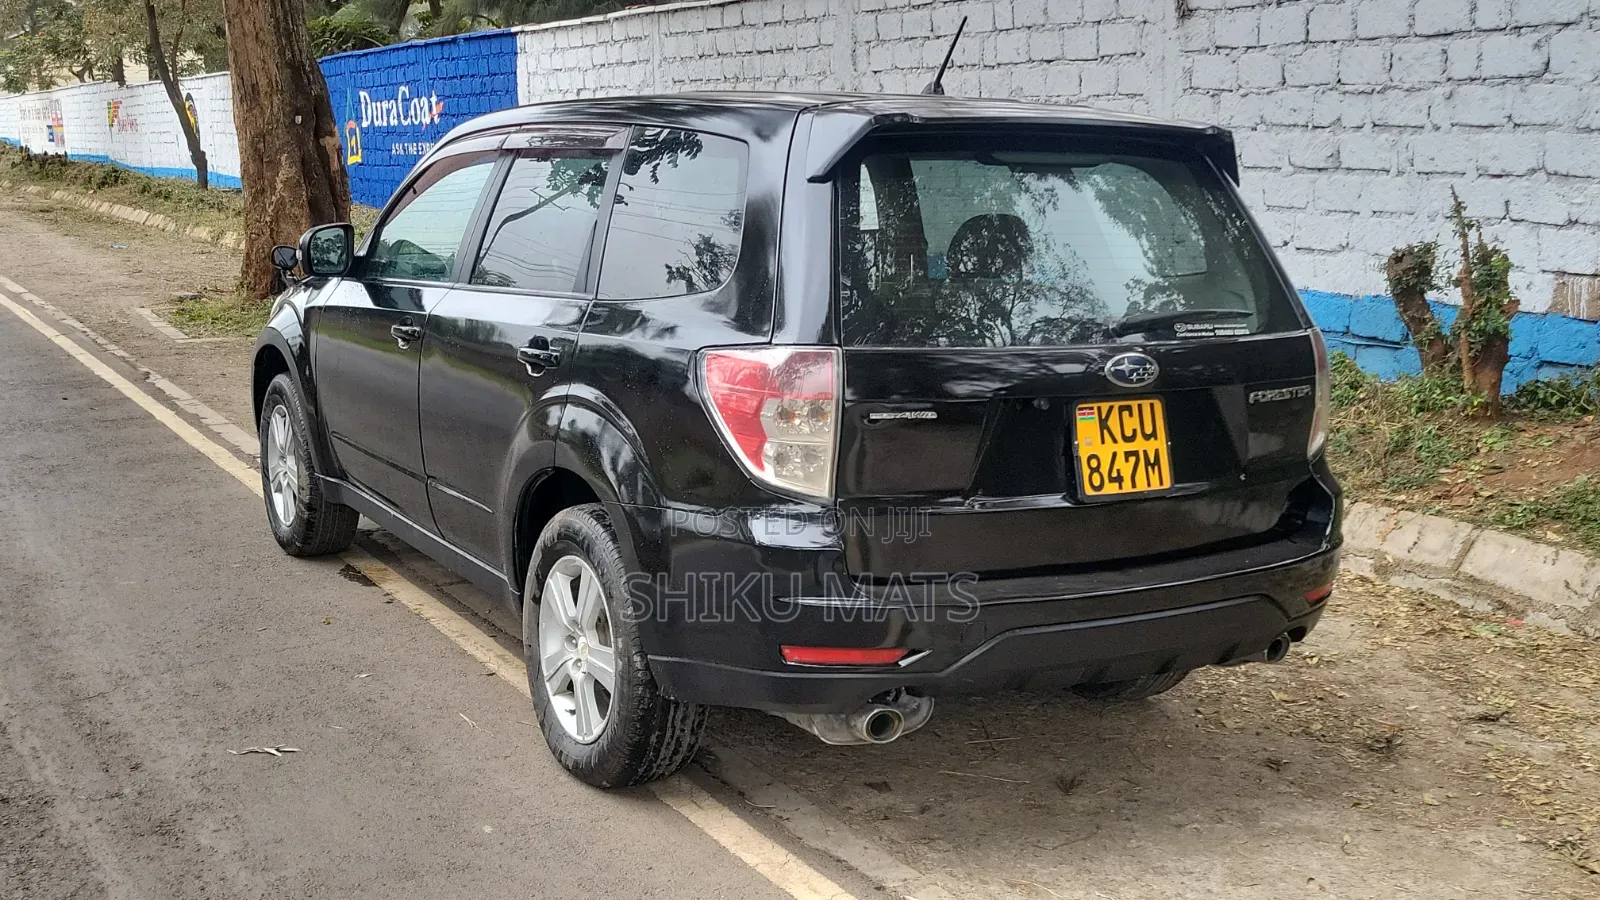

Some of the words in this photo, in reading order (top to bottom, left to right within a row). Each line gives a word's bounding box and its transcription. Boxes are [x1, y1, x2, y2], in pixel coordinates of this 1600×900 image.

[359, 85, 441, 129] DuraCoat
[391, 142, 404, 155] ASK
[404, 142, 417, 155] THE
[1248, 384, 1312, 404] FORESTER
[1097, 402, 1158, 445] KCU
[1086, 449, 1164, 493] 847M
